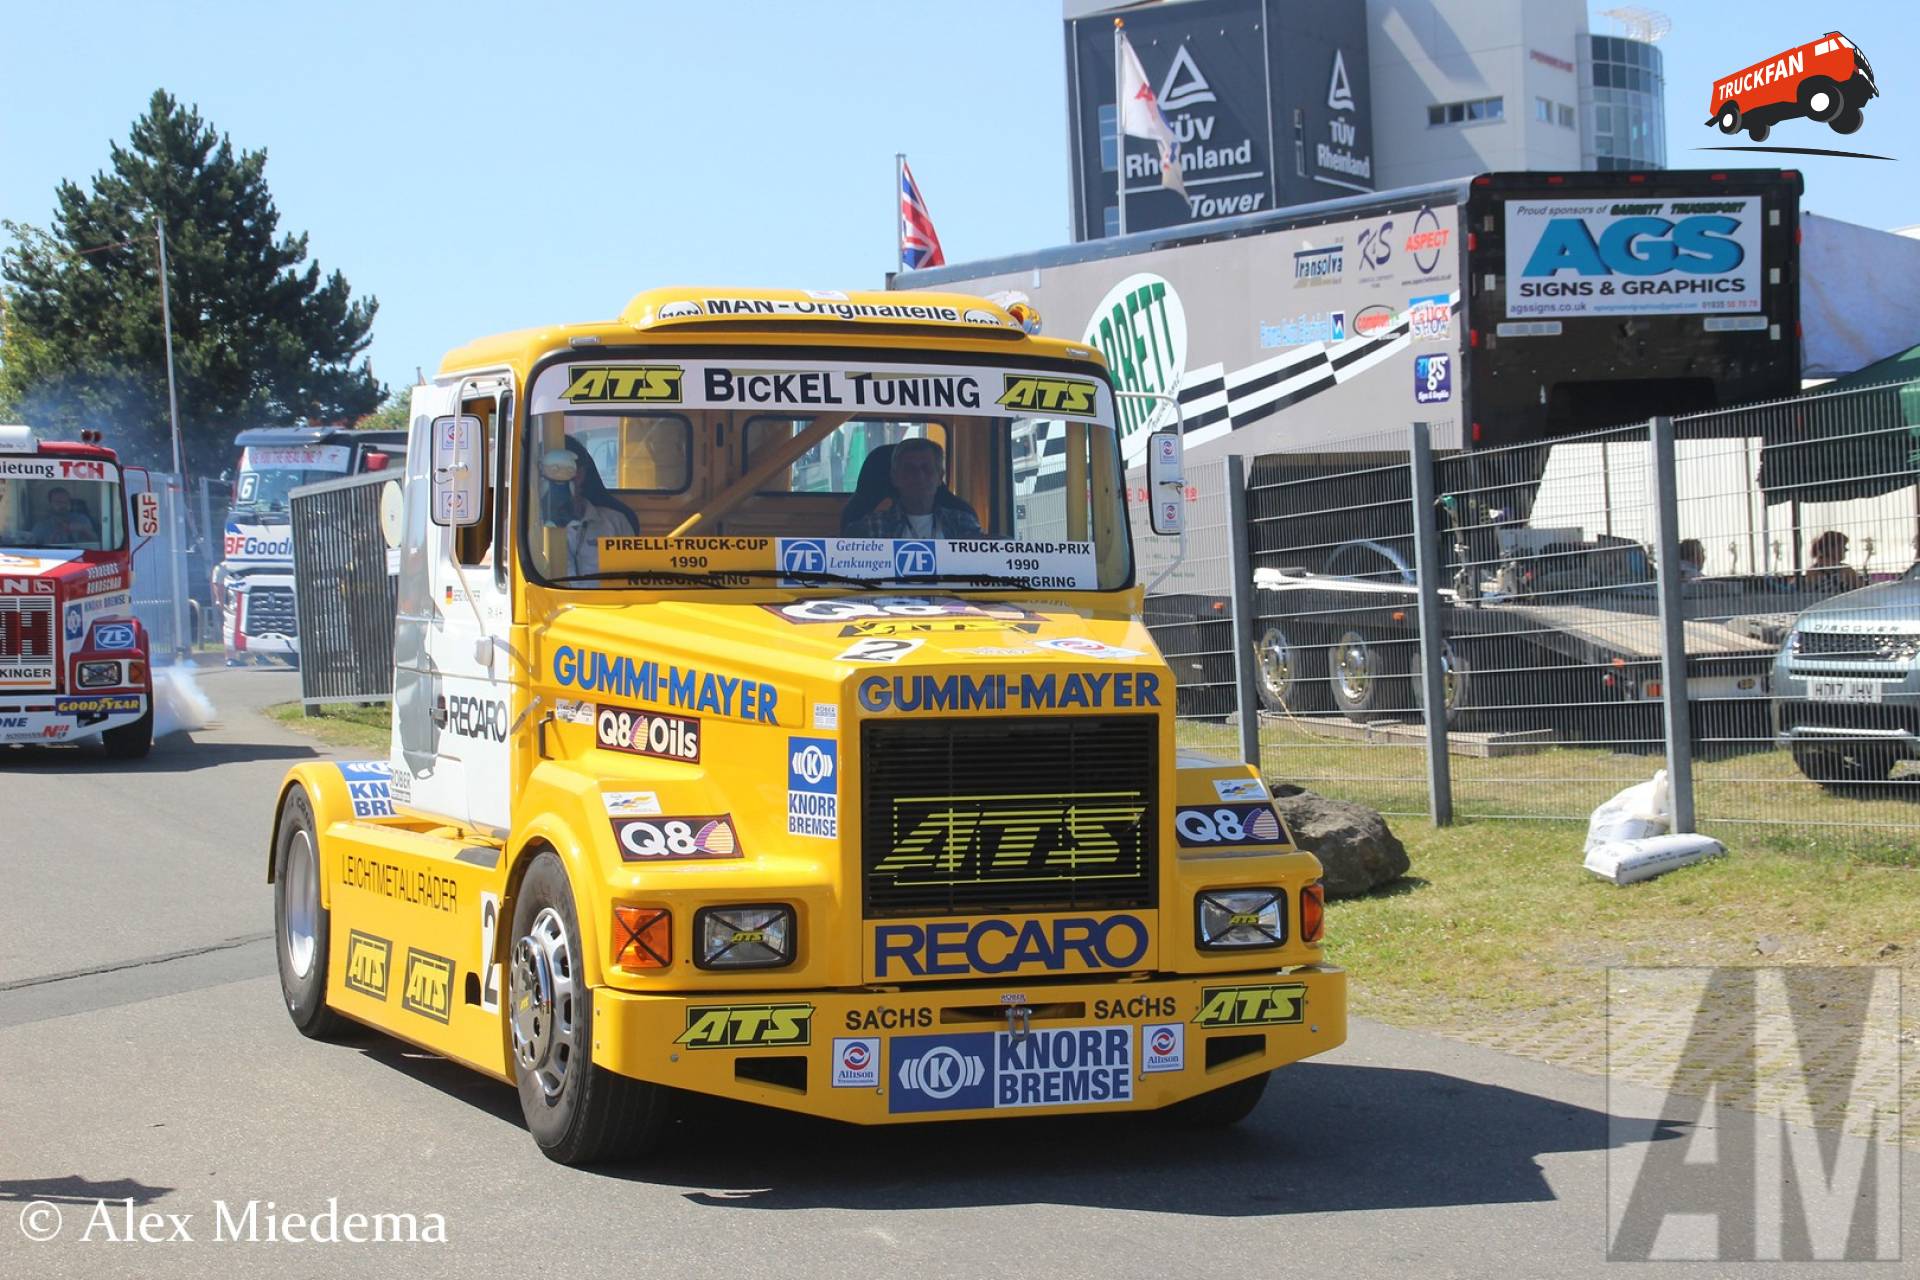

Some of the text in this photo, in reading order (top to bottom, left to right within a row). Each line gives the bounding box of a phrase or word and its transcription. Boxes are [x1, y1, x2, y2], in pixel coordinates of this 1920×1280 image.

[1169, 114, 1215, 143] ÜV
[1329, 119, 1356, 147] TÜV
[1126, 139, 1252, 179] Rhnland
[1317, 143, 1371, 179] Rheinland
[1190, 192, 1264, 219] Tower
[1516, 205, 1547, 216] Proud
[1549, 205, 1594, 217] sponsors
[1596, 204, 1608, 215] of
[1405, 229, 1450, 252] ASPECT
[1521, 215, 1744, 277] AGS
[1520, 278, 1745, 297] SIGNS & GRAPHICS
[1510, 301, 1587, 314] agssigns.co.uk
[1090, 281, 1173, 440] RRETT
[558, 369, 685, 399] ATS
[995, 380, 1097, 411] ATS
[59, 461, 104, 480] TCH
[241, 478, 254, 500] 6
[144, 494, 158, 534] SAF
[224, 537, 293, 556] BFGood
[605, 538, 768, 551] PIRELLI-TRUCK-CUP
[836, 540, 884, 552] Getriebe
[949, 541, 1090, 555] TRUCK-GRAND-PRIX
[670, 556, 707, 568] 1990
[830, 557, 892, 571] Lenkungen
[1006, 559, 1039, 571] 1990
[0, 578, 29, 593] N
[103, 628, 129, 644] ZF
[553, 645, 779, 727] GUMMI-MAYER
[858, 672, 1161, 712] GUMMI-MAYER
[58, 698, 140, 713] GOODYEAR
[449, 695, 507, 743] RECARO
[599, 709, 631, 747] Q8
[650, 717, 697, 758] Oils
[350, 783, 391, 799] KN
[789, 793, 836, 818] KNORR
[621, 820, 698, 856] Q8
[789, 816, 836, 837] BREMSE
[874, 805, 1146, 870] ATS
[1176, 809, 1247, 842] Q8
[342, 854, 457, 914] LEICHTMETALLRÄDER
[1231, 914, 1259, 925] ATS
[731, 932, 764, 942] ATS
[875, 914, 1149, 977] RECARO
[349, 941, 388, 988] ATS
[484, 900, 498, 1004] 2
[406, 962, 450, 1010] ATS
[1094, 996, 1176, 1019] SACHS
[1191, 986, 1308, 1023] ATS
[673, 1006, 815, 1044] ATS
[845, 1007, 933, 1030] SACHS
[1000, 1029, 1129, 1071] KNORR
[1148, 1055, 1179, 1064] Allison
[838, 1070, 873, 1079] Allison
[1000, 1068, 1129, 1105] BREMSE
